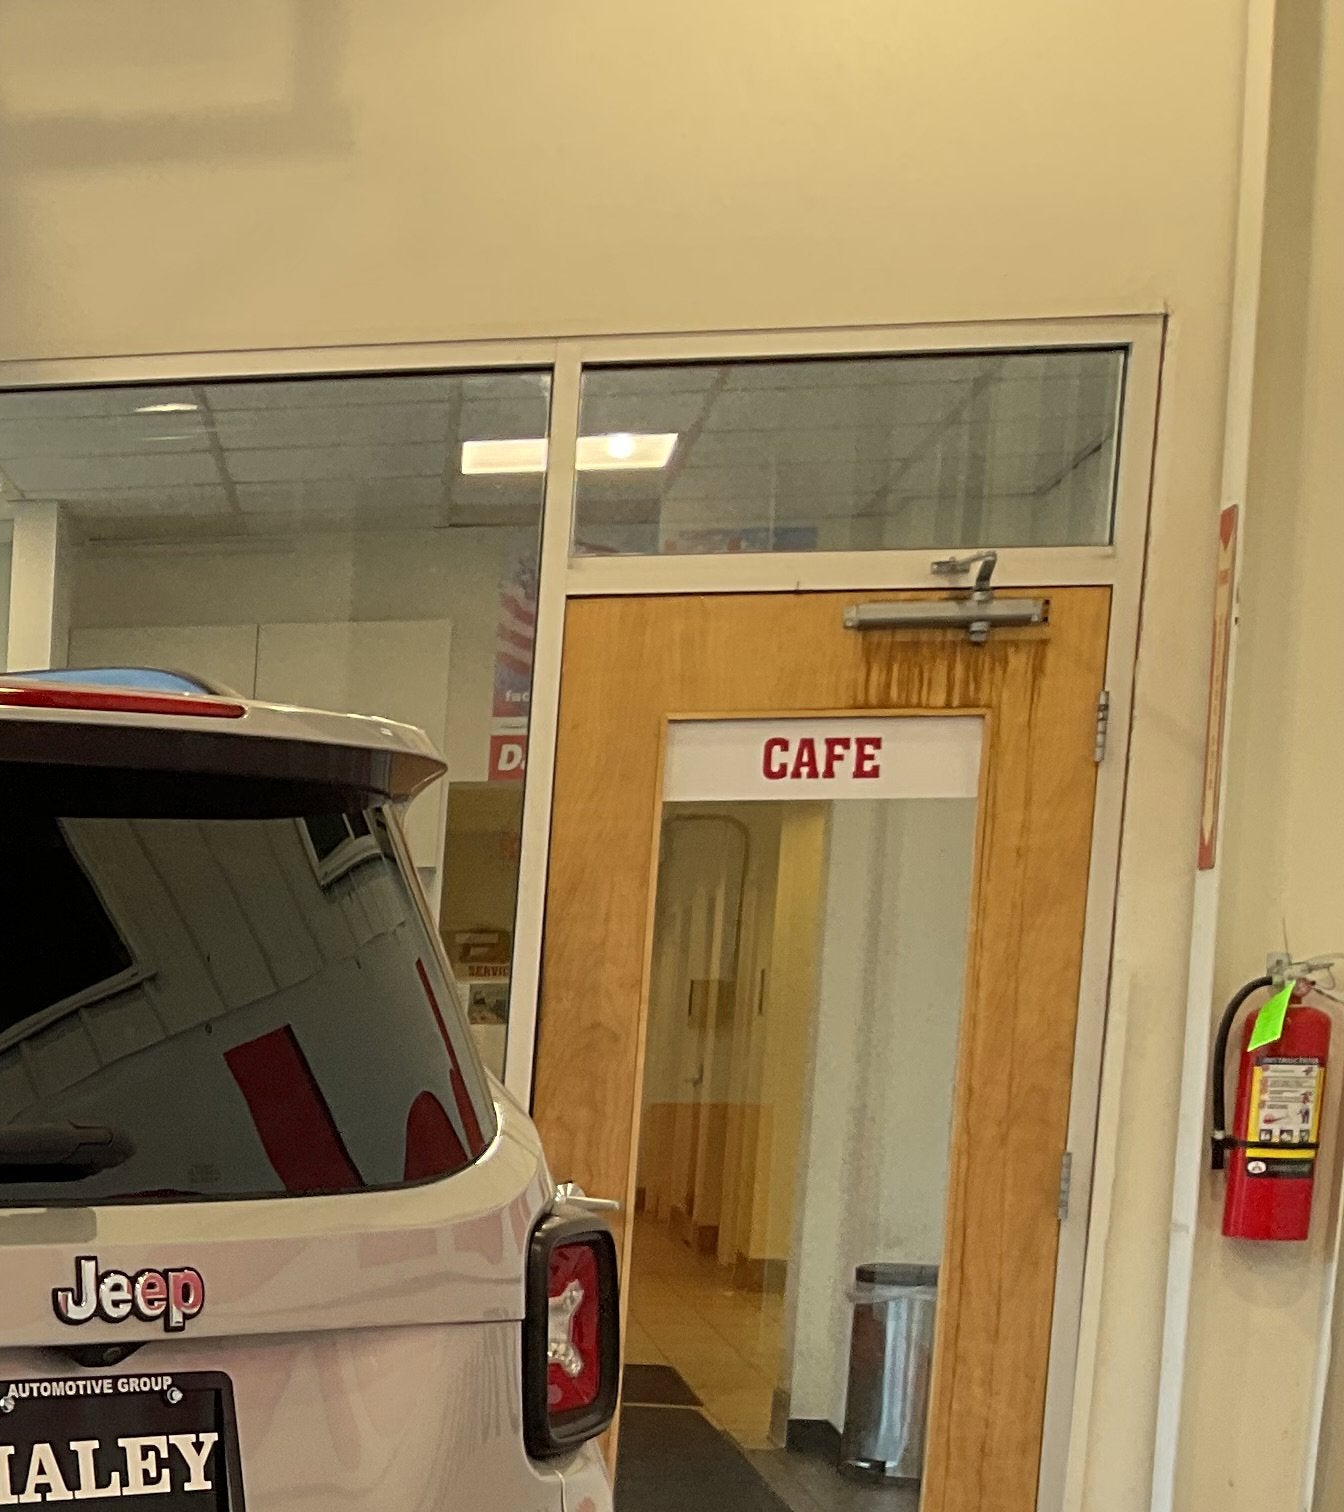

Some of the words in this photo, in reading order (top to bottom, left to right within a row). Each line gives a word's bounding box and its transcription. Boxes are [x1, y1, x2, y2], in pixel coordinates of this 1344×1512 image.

[497, 743, 526, 771] D
[762, 737, 883, 779] CAFE
[52, 1256, 205, 1332] Jeep
[7, 1378, 113, 1399] AUTOMOTIVE
[117, 1375, 173, 1392] GROUP
